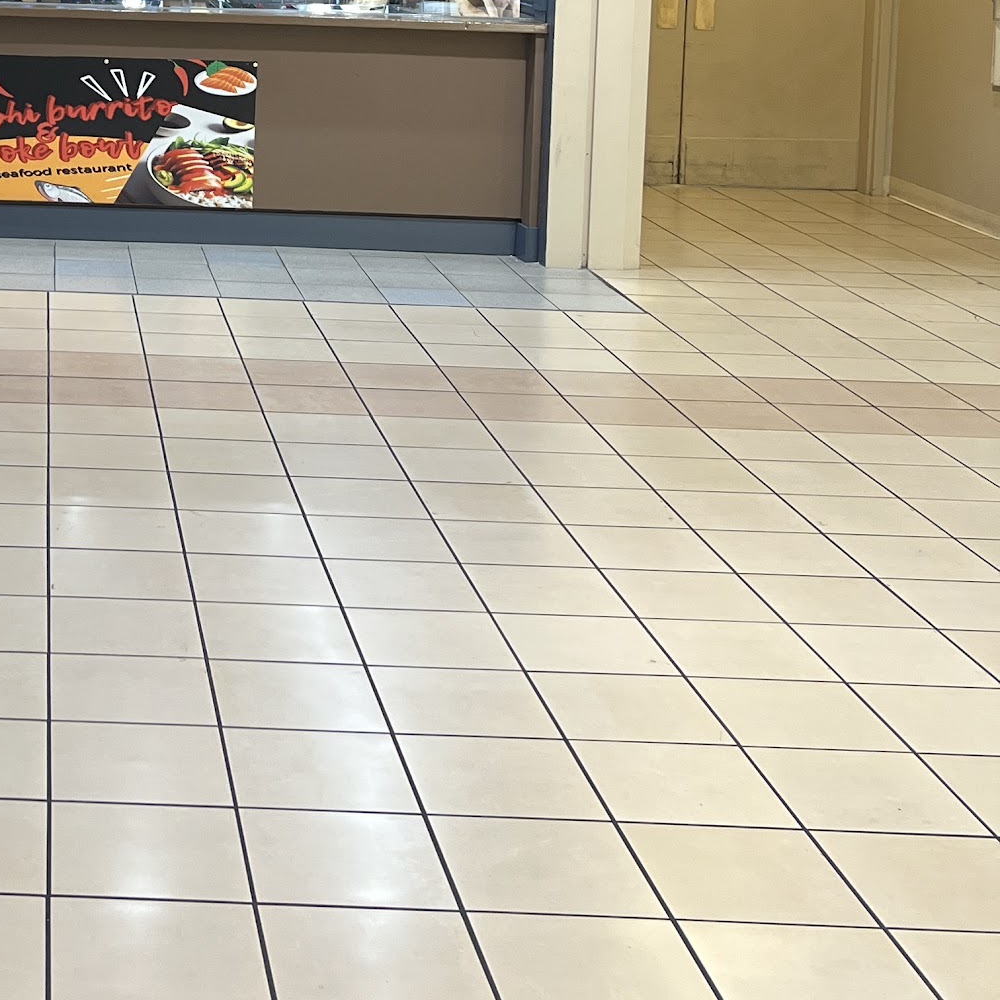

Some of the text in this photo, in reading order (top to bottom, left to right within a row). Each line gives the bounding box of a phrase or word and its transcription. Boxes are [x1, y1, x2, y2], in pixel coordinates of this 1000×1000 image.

[46, 95, 178, 126] burrito
[36, 122, 59, 143] &
[59, 131, 144, 162] bowl
[56, 163, 132, 175] restaurant
